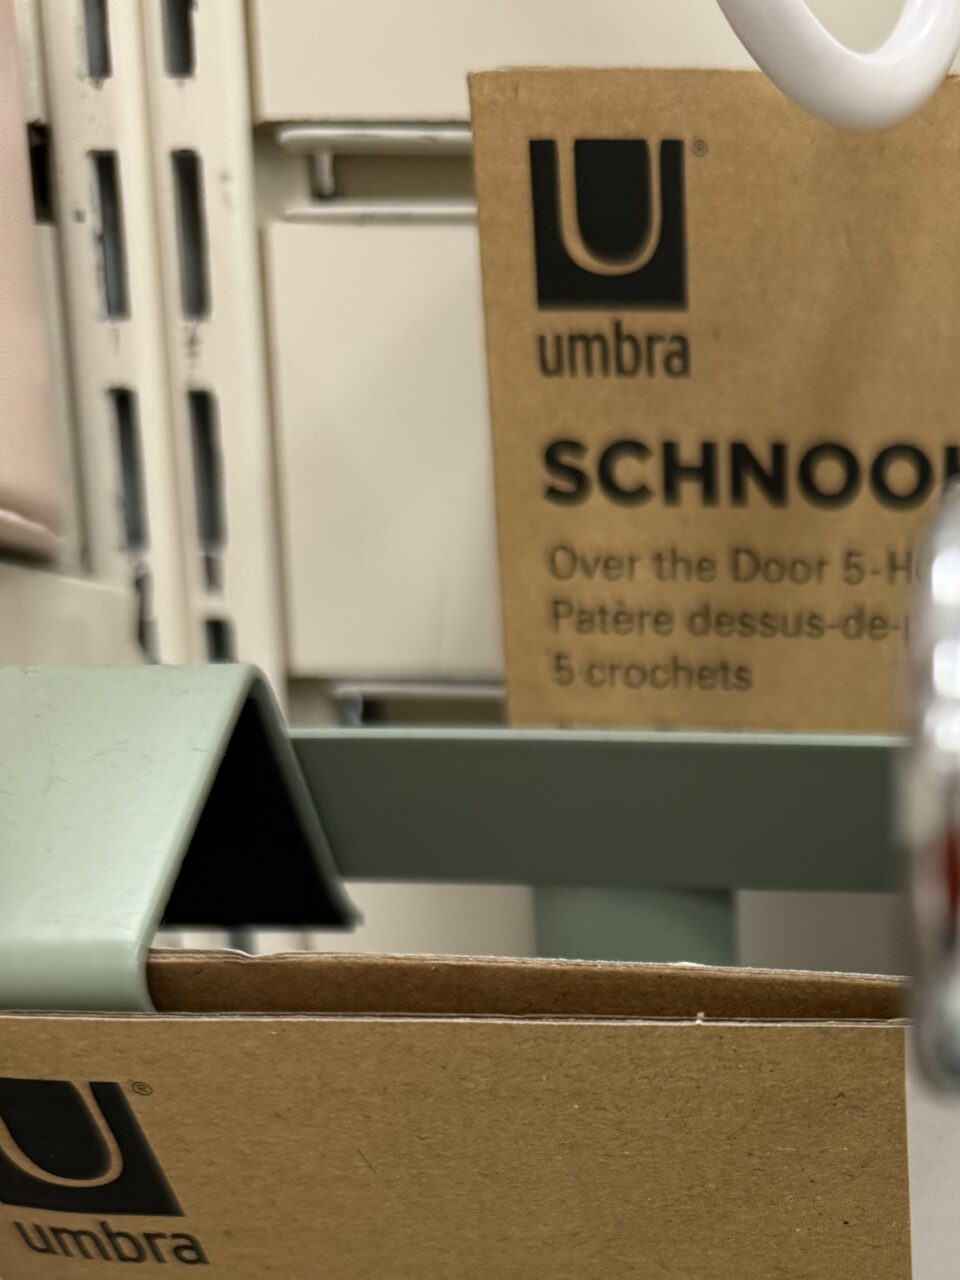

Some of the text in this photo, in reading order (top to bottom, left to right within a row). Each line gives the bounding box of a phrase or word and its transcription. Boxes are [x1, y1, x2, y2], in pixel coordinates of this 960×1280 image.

[536, 320, 692, 379] umbra
[548, 545, 641, 584] Over
[652, 549, 718, 585] the
[728, 548, 829, 587] Door
[550, 599, 675, 639] Patère
[554, 653, 755, 693] 5 crochets
[13, 1219, 210, 1265] umbra
